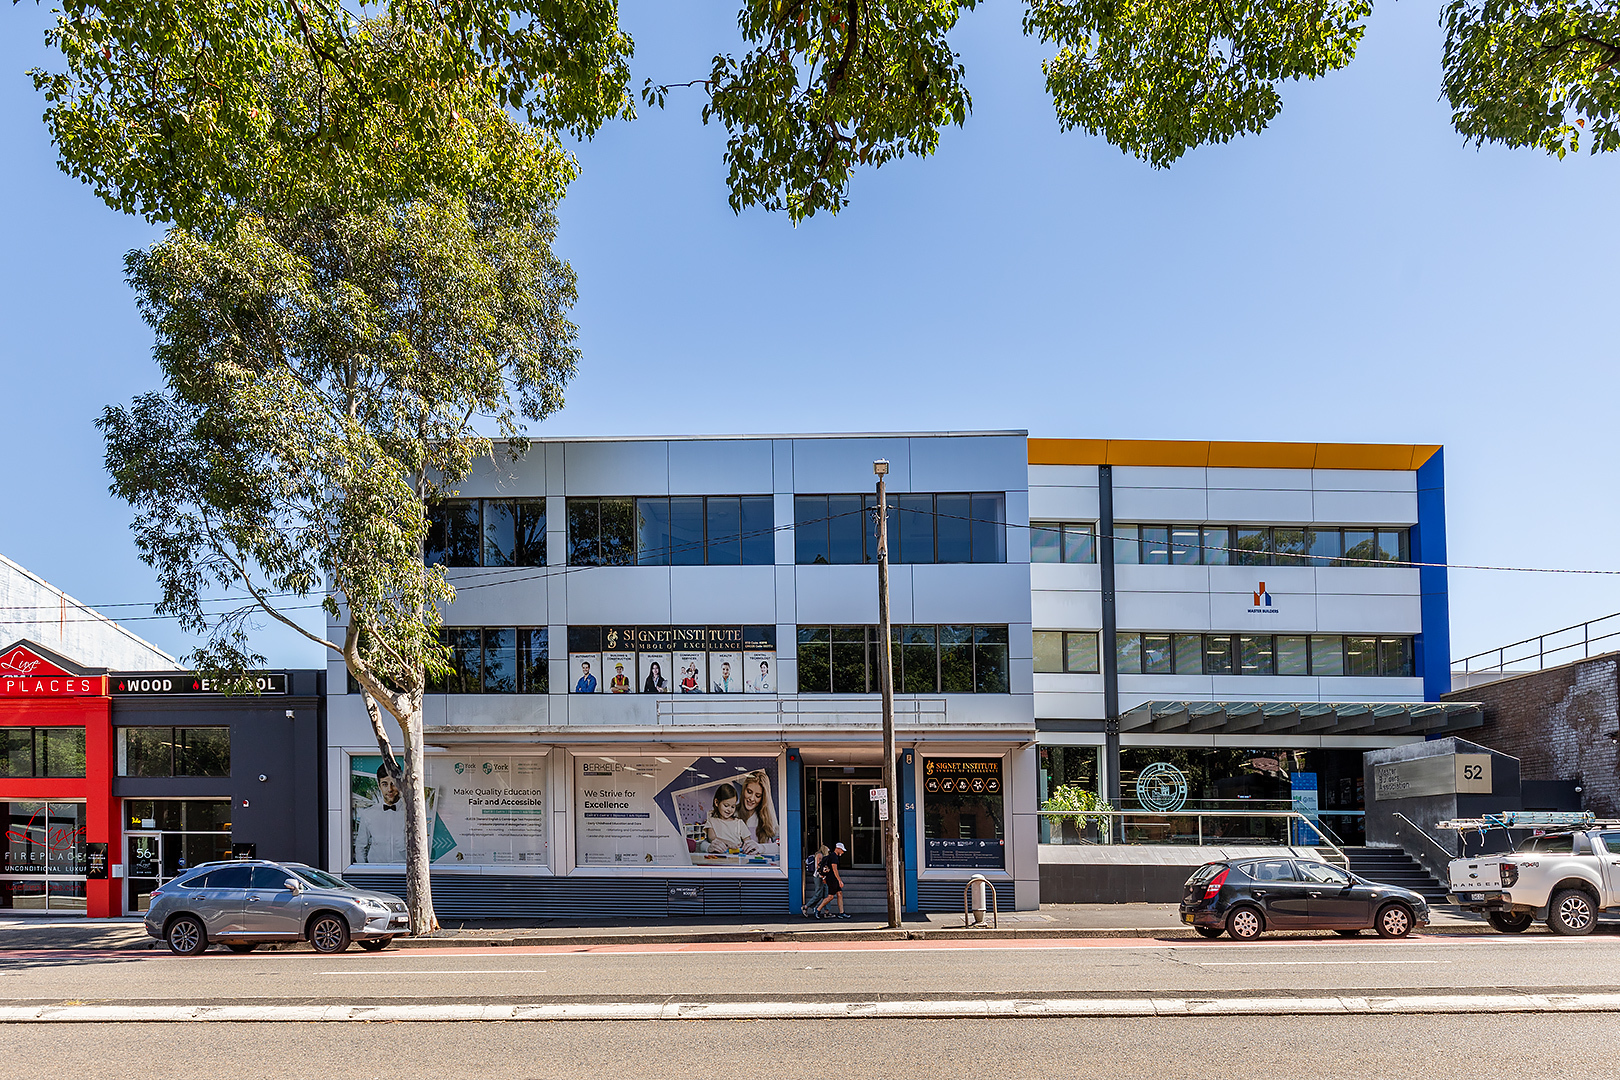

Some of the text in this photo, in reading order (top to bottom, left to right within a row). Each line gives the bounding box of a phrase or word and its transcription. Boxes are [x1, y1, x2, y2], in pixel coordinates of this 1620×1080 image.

[623, 629, 741, 641] SIGNET INSTITUTE
[1, 650, 41, 674] Luxe
[6, 679, 90, 692] PLACES
[127, 679, 173, 692] WOOD
[201, 677, 276, 691] ETOL
[583, 763, 627, 772] BERKELEY
[935, 762, 998, 770] SIGNET INSTITUTE
[1379, 768, 1397, 776] Master
[1463, 764, 1483, 780] 52
[1379, 782, 1410, 790] Association
[475, 788, 502, 797] Quality
[599, 789, 623, 797] Strive
[624, 789, 636, 797] for
[4, 852, 86, 860] FIREPLACE
[136, 848, 152, 858] 56
